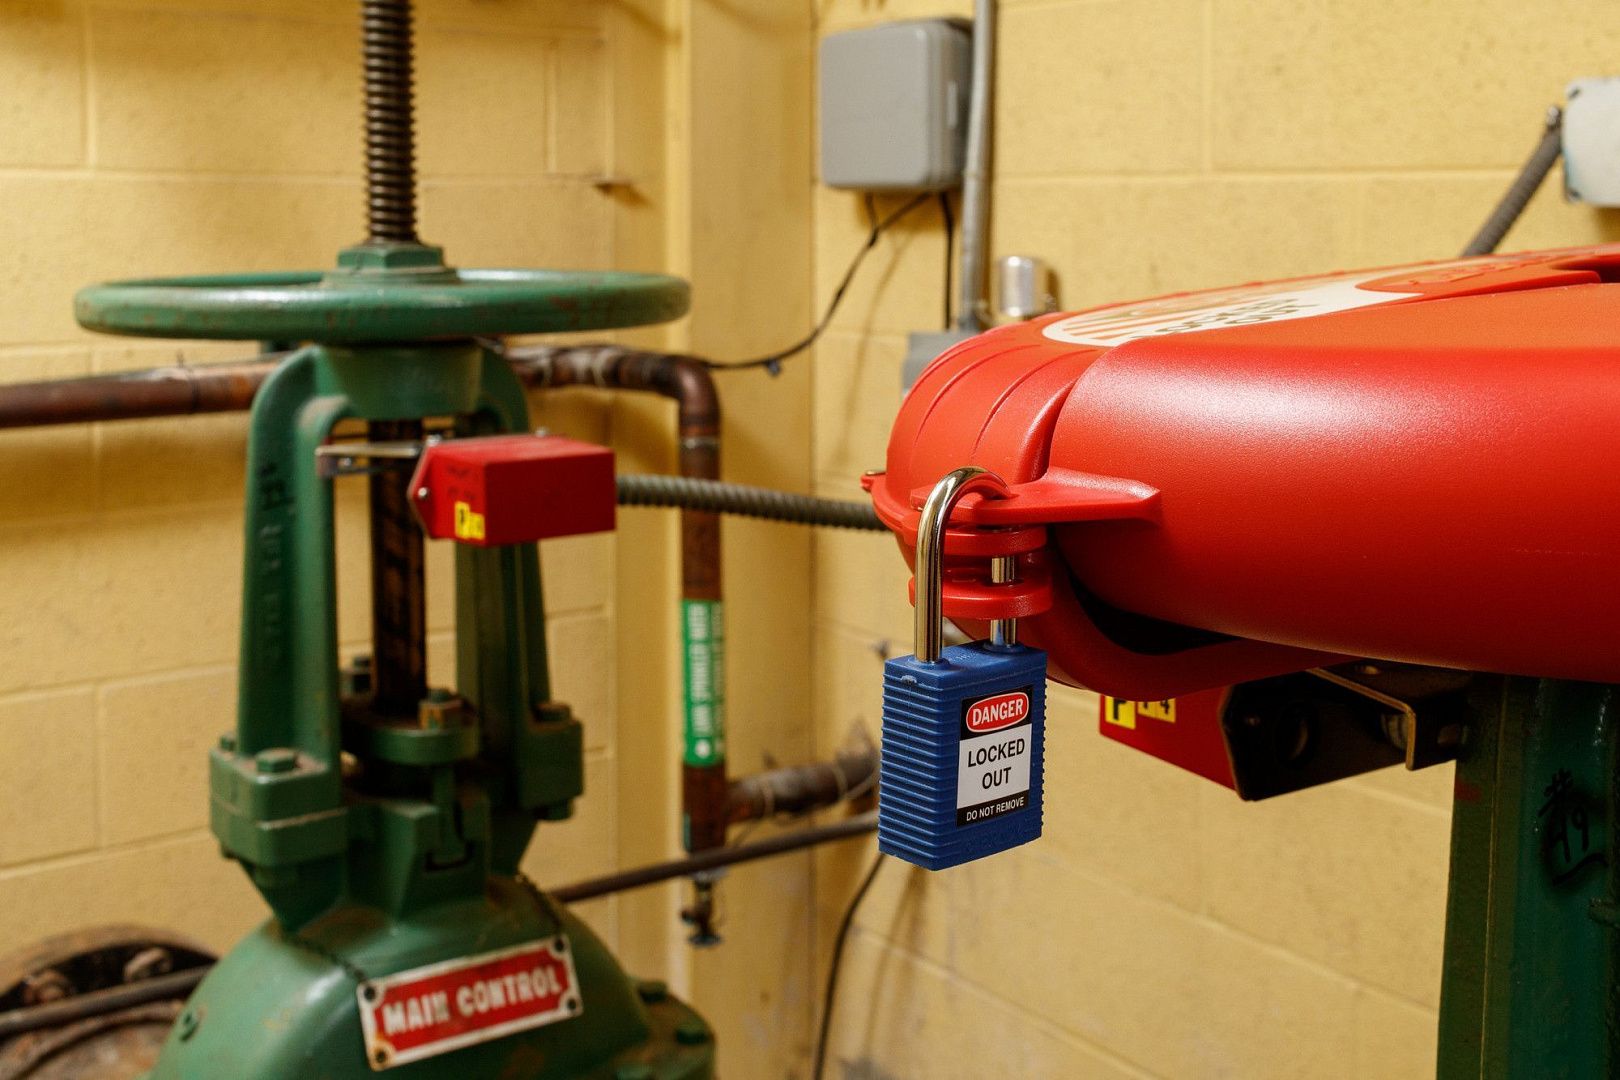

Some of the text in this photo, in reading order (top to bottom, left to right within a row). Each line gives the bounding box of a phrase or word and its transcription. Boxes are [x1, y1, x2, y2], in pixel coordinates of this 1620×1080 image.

[972, 698, 1024, 726] DANGER
[968, 738, 1025, 767] LOCKED
[982, 767, 1012, 789] OUT
[966, 796, 1025, 822] DO NOT REMOVE
[382, 964, 563, 1036] MAIN CONTROL
